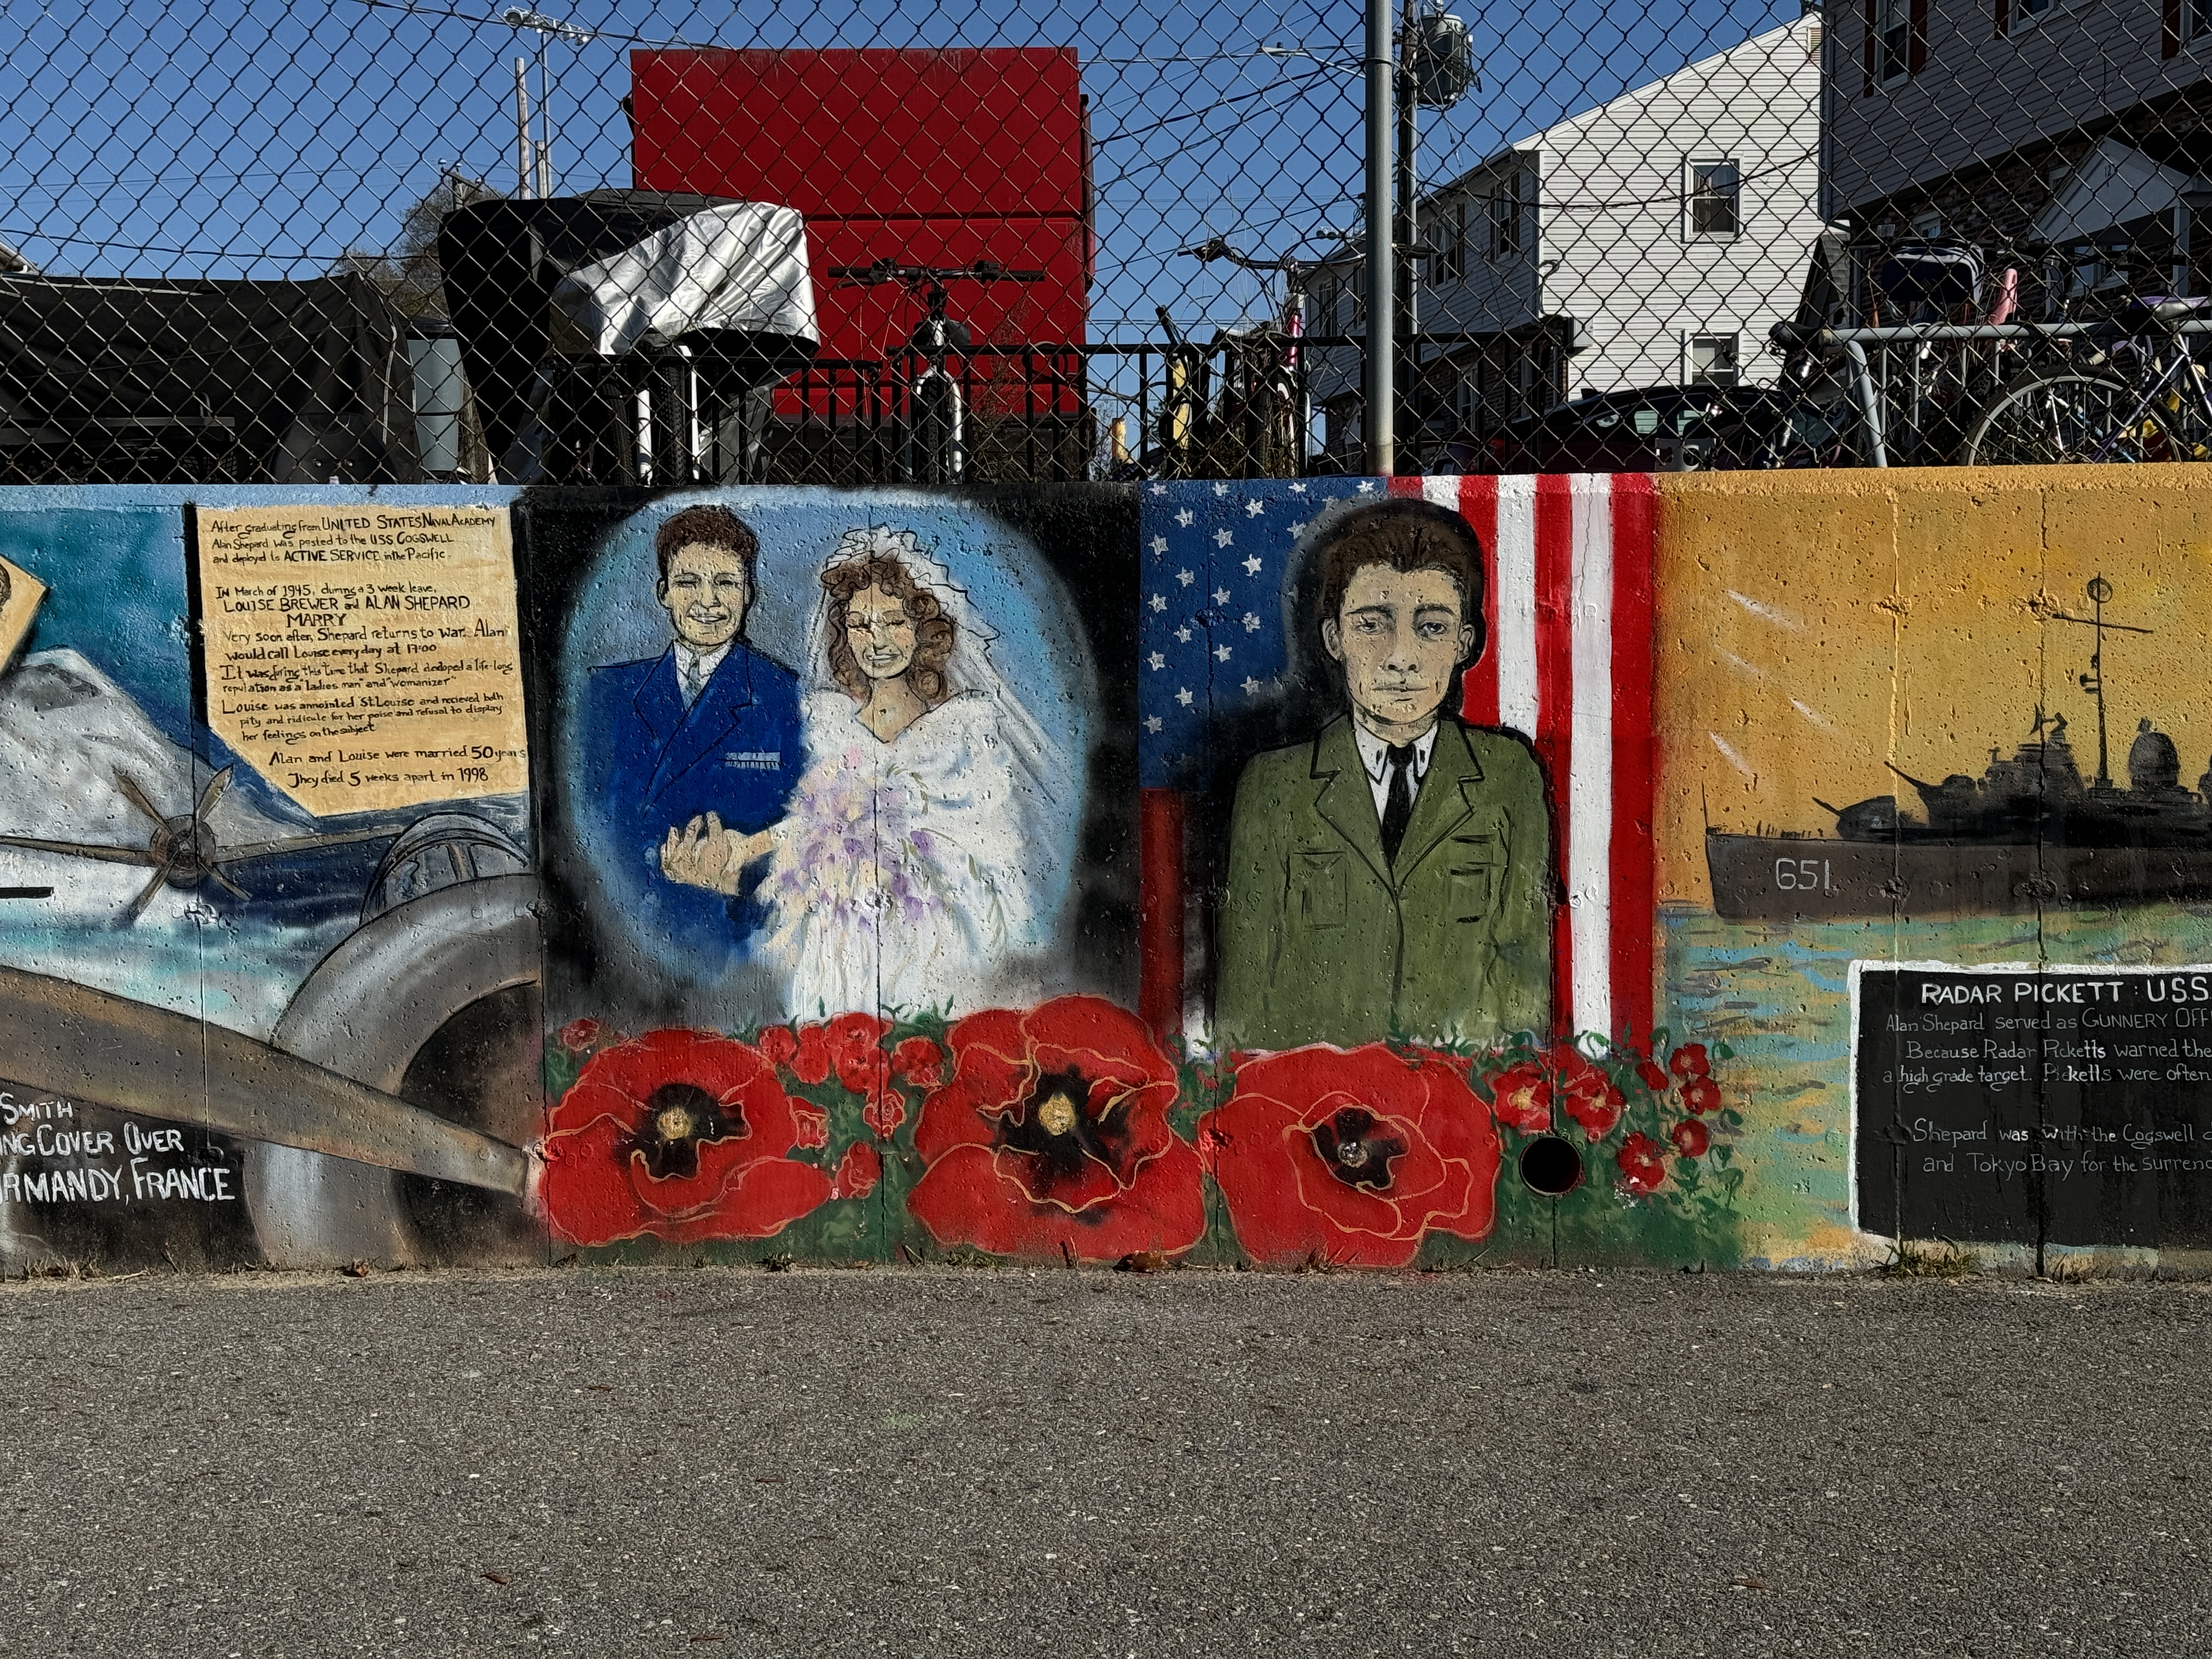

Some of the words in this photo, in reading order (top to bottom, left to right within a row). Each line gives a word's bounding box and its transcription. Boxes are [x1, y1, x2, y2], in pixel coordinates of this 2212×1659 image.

[211, 520, 242, 533] After
[238, 520, 297, 539] graduating
[298, 520, 321, 532] from
[321, 517, 370, 532] UNITED
[377, 515, 422, 529] STATES
[212, 538, 232, 549] Alan
[233, 538, 269, 551] Shepard
[299, 534, 333, 549] posted
[336, 534, 348, 545] to
[349, 533, 366, 545] the
[370, 534, 394, 545] USS
[397, 532, 455, 545] COGSWELL
[213, 553, 228, 564] and
[232, 551, 267, 566] deployed
[270, 550, 280, 562] to
[284, 550, 329, 562] ACTIVE
[330, 548, 381, 562] SERVICE
[235, 585, 263, 597] March
[267, 585, 278, 596] of
[321, 583, 357, 600] during
[366, 584, 375, 594] 3
[377, 582, 405, 594] week
[223, 599, 275, 613] LOUISE
[279, 597, 339, 612] BREWER
[344, 599, 359, 610] and
[365, 595, 400, 610] ALAN
[404, 595, 471, 611] SHEPARD
[285, 612, 347, 628] MARRY
[223, 630, 251, 646] Very
[255, 632, 283, 642] soon
[317, 625, 367, 642] Shepard
[371, 626, 417, 639] returns
[421, 626, 435, 639] to
[473, 618, 505, 637] Alan
[224, 647, 267, 662] would
[267, 647, 289, 659] call
[293, 645, 330, 659] Louise
[331, 648, 359, 659] every
[361, 644, 382, 658] day
[387, 642, 402, 654] at
[407, 644, 437, 654] 17:00
[219, 664, 243, 680] It
[245, 670, 270, 679] was
[302, 664, 322, 676] this
[321, 662, 346, 676] time
[347, 662, 370, 674] that
[375, 662, 419, 677] Shepard
[222, 682, 277, 697] reputation
[279, 684, 293, 692] as
[365, 678, 387, 688] and
[221, 699, 270, 714] Louise
[274, 703, 296, 711] was
[419, 696, 439, 706] and
[483, 692, 504, 702] both
[240, 715, 261, 729] pity
[266, 715, 285, 725] and
[286, 713, 327, 724] ridicule
[331, 712, 344, 721] for
[346, 711, 366, 721] her
[396, 708, 414, 716] and
[416, 707, 449, 716] refusal
[450, 706, 462, 714] to
[465, 703, 503, 715] display
[241, 730, 258, 742] her
[262, 729, 307, 745] feelings
[321, 726, 339, 736] the
[339, 722, 377, 736] subject
[268, 751, 303, 766] Alan
[308, 750, 333, 763] and
[337, 748, 380, 763] Louise
[384, 750, 410, 759] were
[414, 745, 469, 758] married
[471, 745, 494, 759] 50
[321, 769, 345, 784] died
[347, 769, 362, 787] 5
[364, 772, 400, 782] weeks
[403, 769, 439, 784] apart
[441, 771, 455, 782] in
[456, 767, 489, 783] 1998
[1775, 857, 1830, 890] 651
[1921, 983, 2003, 1006] RADAR
[2015, 981, 2124, 1004] PICKETT
[1886, 1013, 1919, 1032] Alan
[1921, 1012, 1985, 1035] Shepard
[1995, 1011, 2051, 1030] served
[2056, 1018, 2078, 1029] as
[2081, 1007, 2169, 1029] GUNNERY
[1905, 1040, 1979, 1059] Because
[1983, 1038, 2038, 1059] Radar
[2113, 1038, 2180, 1058] warned
[1883, 1070, 1893, 1084] a
[1898, 1064, 1929, 1094] high
[1926, 1068, 1975, 1093] grade
[1977, 1065, 2033, 1092] target.
[2117, 1069, 2162, 1082] were
[2166, 1063, 2212, 1081] often
[0, 1091, 74, 1125] SMITH
[37, 1124, 115, 1156] COVER
[123, 1121, 184, 1155] OVER
[1912, 1118, 1988, 1148] Shepard
[1999, 1128, 2029, 1142] was
[2090, 1125, 2118, 1142] the
[2123, 1123, 2195, 1150] Cogswell
[1923, 1152, 1954, 1172] and
[1966, 1152, 2027, 1181] Tokyo
[2030, 1153, 2075, 1181] Bay
[2080, 1149, 2107, 1173] for
[2112, 1154, 2138, 1172] the
[0, 1164, 129, 1207] RMANDY,
[129, 1156, 236, 1202] FRANCE
